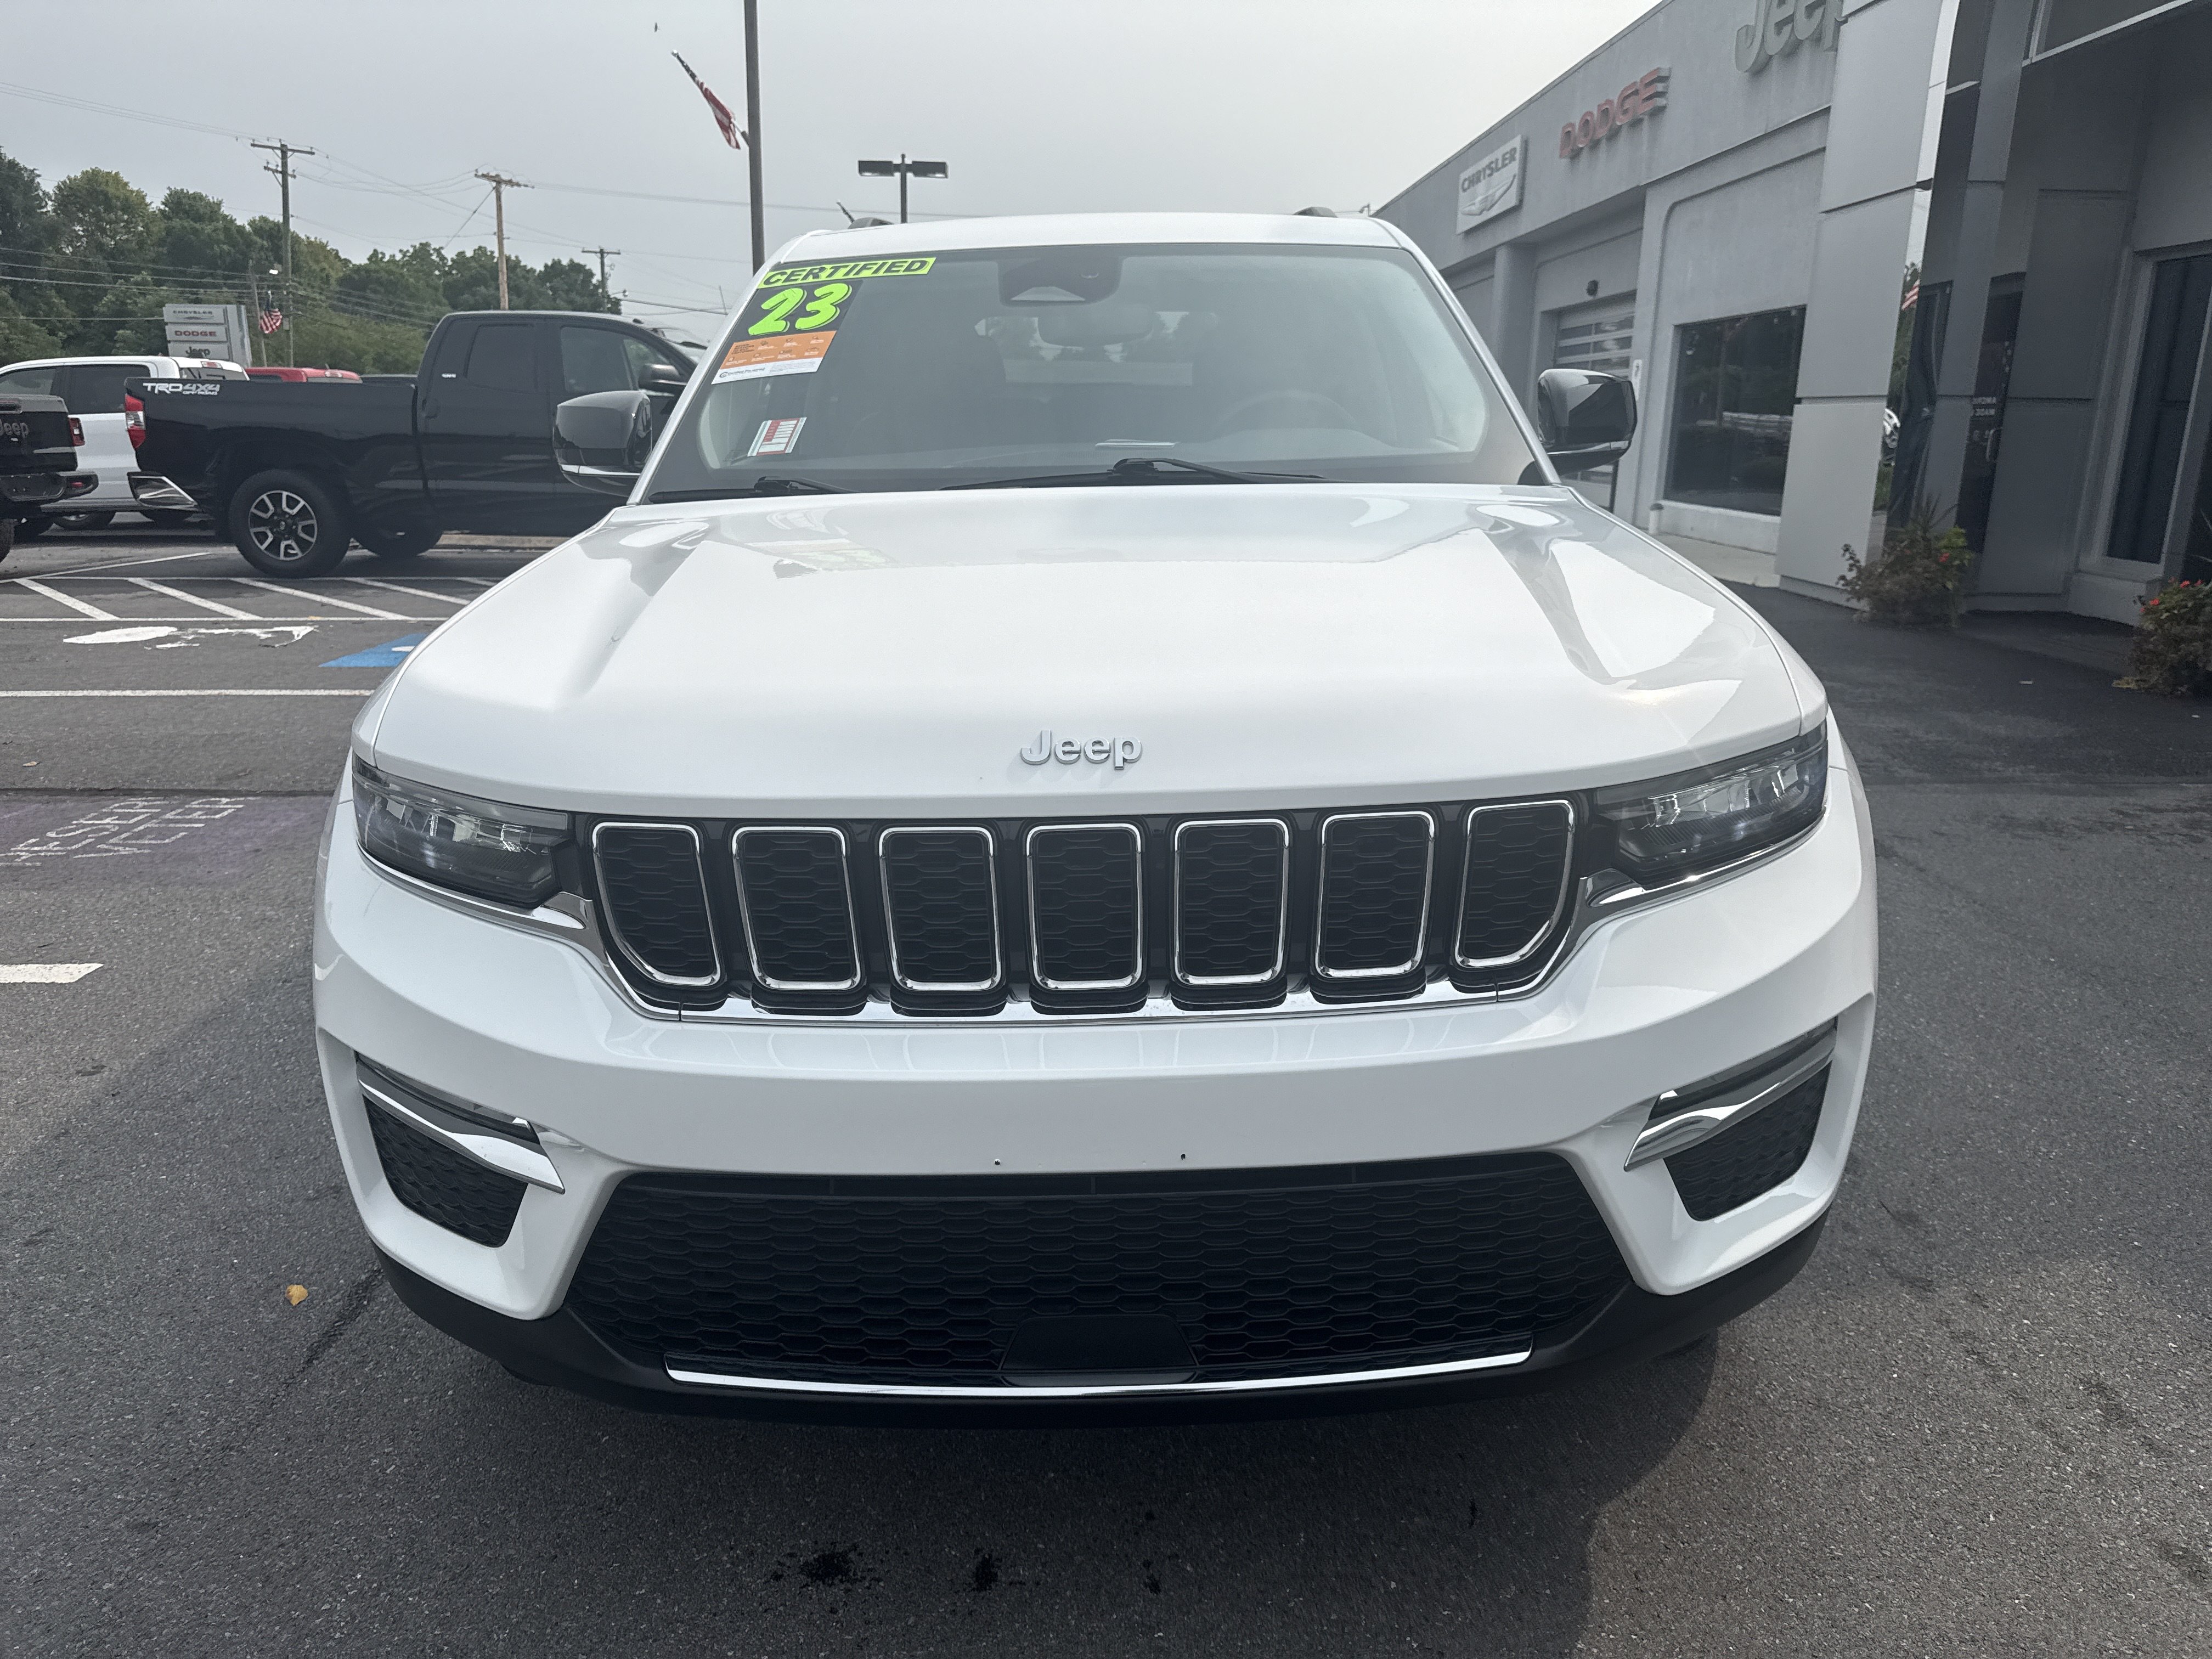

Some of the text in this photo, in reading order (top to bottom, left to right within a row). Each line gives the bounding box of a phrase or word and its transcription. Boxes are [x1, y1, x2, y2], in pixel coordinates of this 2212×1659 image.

[1559, 67, 1671, 159] DODGE
[1462, 147, 1517, 193] CHRYSLER
[763, 259, 930, 286] CERTIFIED
[748, 283, 853, 336] 23
[143, 382, 183, 394] TRD
[1020, 729, 1143, 771] Jeep
